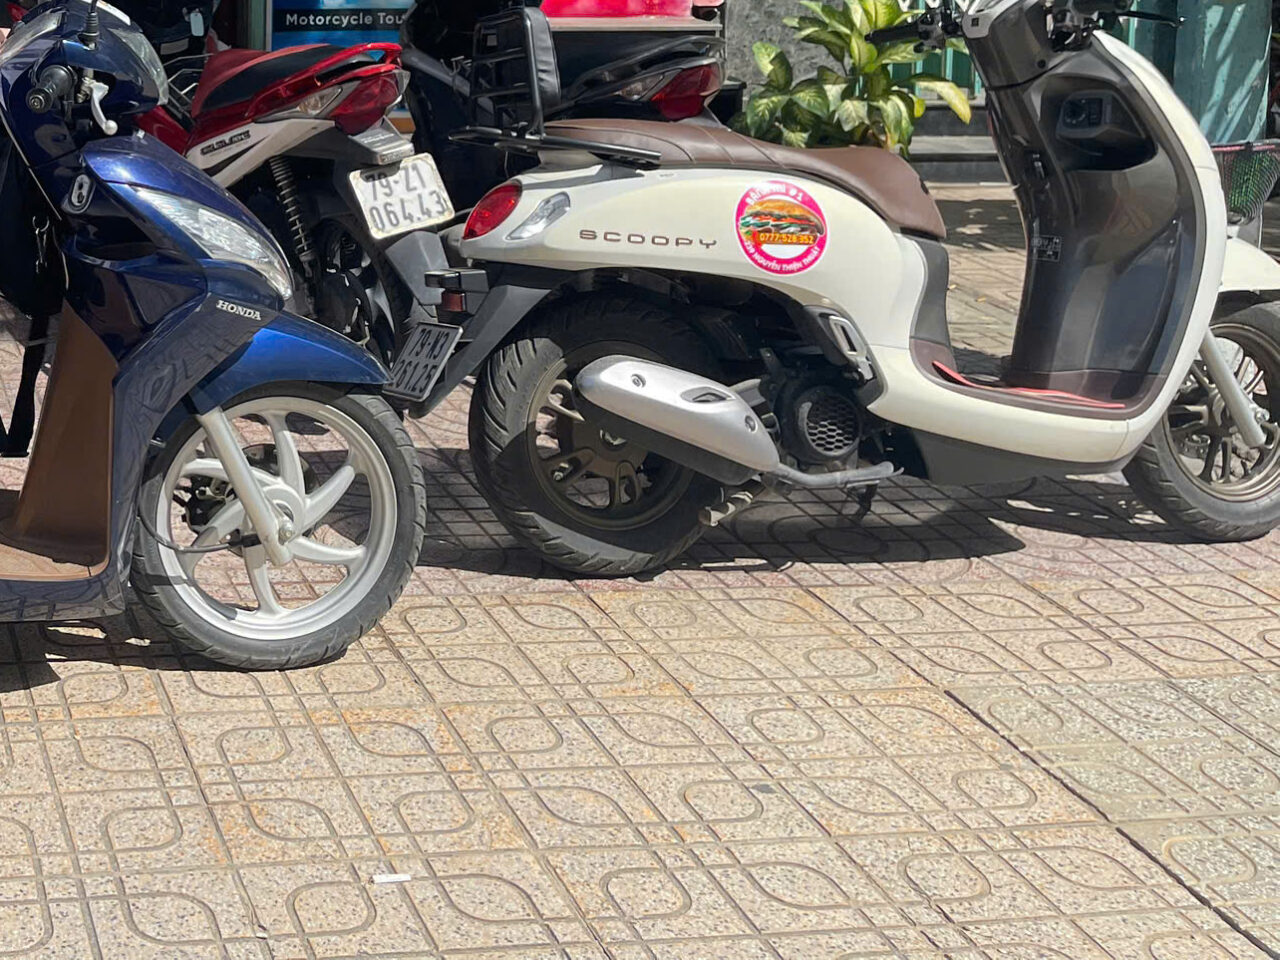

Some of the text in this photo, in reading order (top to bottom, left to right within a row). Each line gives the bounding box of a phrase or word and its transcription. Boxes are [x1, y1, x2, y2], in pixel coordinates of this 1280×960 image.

[285, 12, 406, 29] Motorcycle Tou
[369, 190, 446, 231] 064.43
[579, 229, 717, 249] SCOOPY
[216, 299, 262, 321] HONDA
